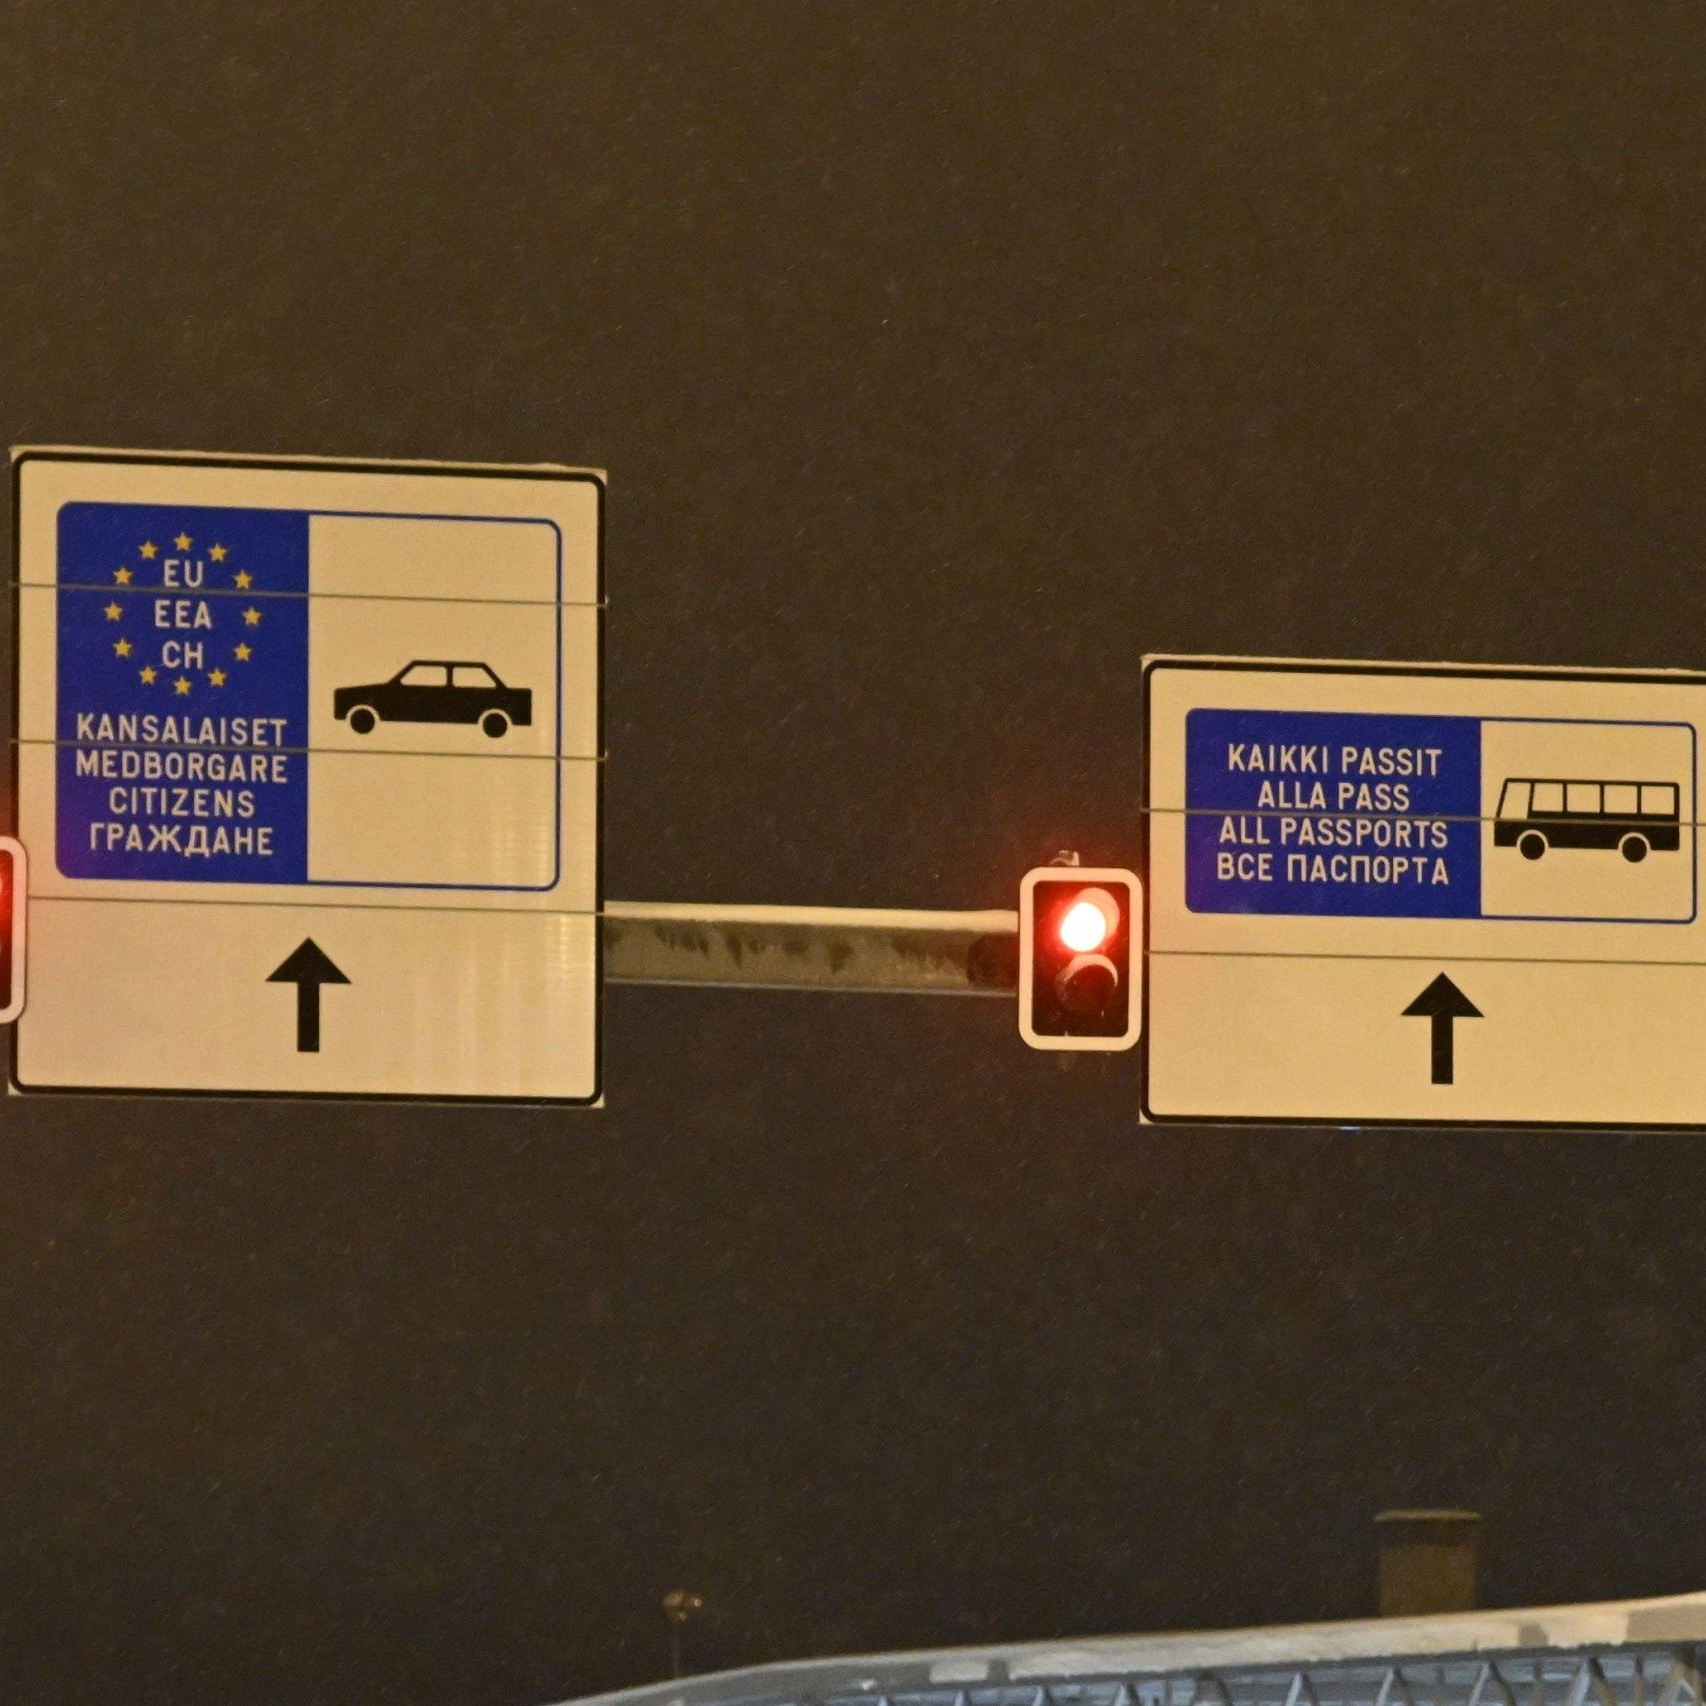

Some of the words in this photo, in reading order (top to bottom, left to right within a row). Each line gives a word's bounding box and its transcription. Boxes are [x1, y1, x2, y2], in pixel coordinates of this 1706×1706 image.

[163, 559, 204, 588] EU
[154, 599, 212, 629] EEA
[162, 640, 204, 669] CH
[77, 712, 287, 747] KANSALAISET
[76, 749, 288, 784] MEDBORGARE
[1228, 743, 1329, 774] KAIKKI
[1341, 746, 1442, 777] PASSIT
[109, 786, 255, 818] CITIZENS
[1257, 780, 1327, 810] ALLA
[1338, 782, 1410, 812] PASS
[90, 822, 273, 857] ГРАЖДАНЕ
[1219, 815, 1271, 845] ALL
[1280, 816, 1449, 849] PASSPORTS
[1217, 852, 1273, 882] ВСЕ
[1287, 853, 1449, 885] ПАСПОРТА
